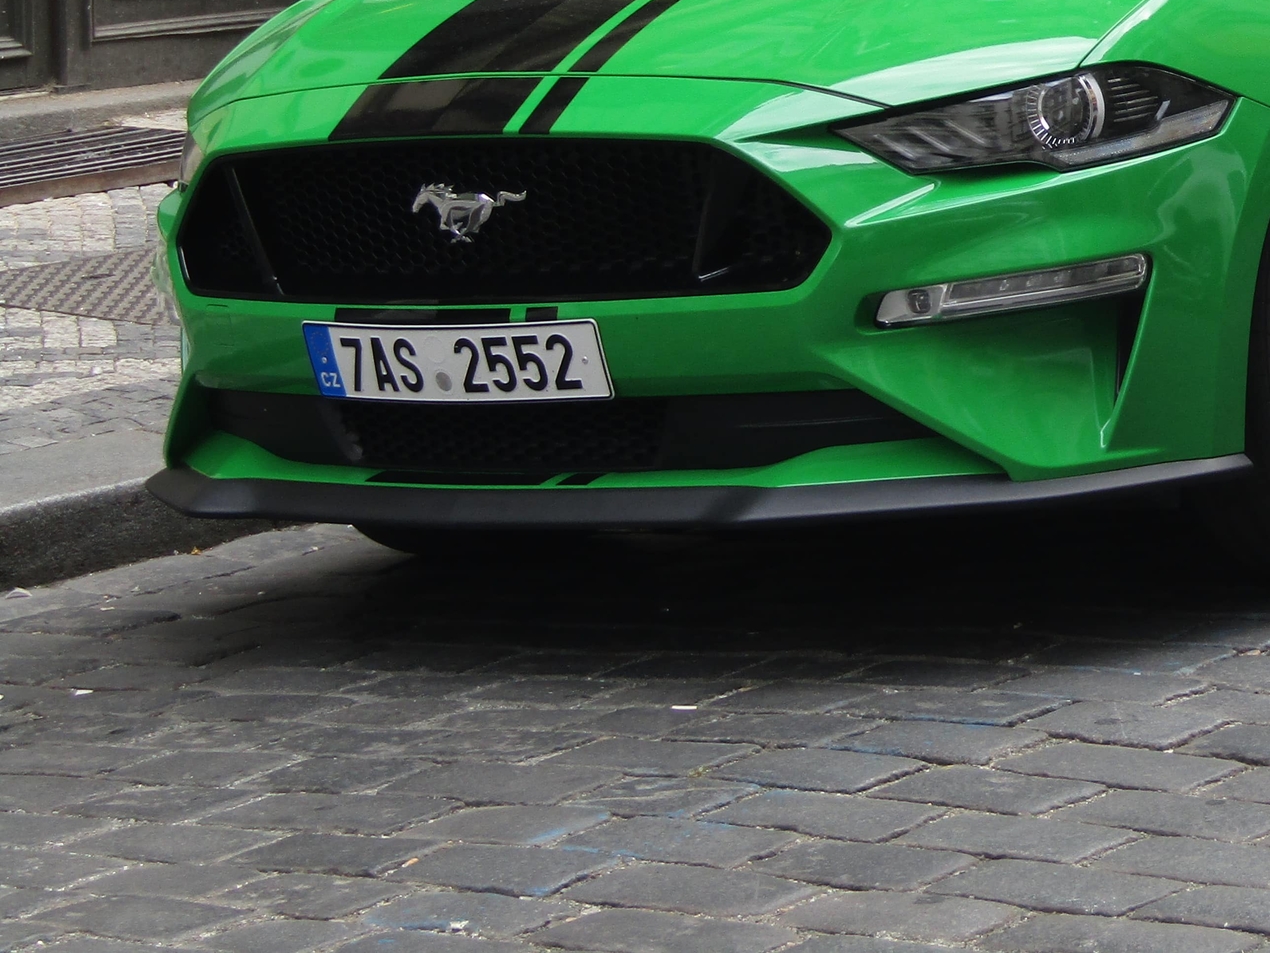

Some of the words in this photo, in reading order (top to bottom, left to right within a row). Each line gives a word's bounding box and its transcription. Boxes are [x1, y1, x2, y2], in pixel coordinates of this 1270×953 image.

[321, 372, 341, 389] CZ
[340, 336, 424, 393] 7AS
[454, 334, 583, 393] 2552
